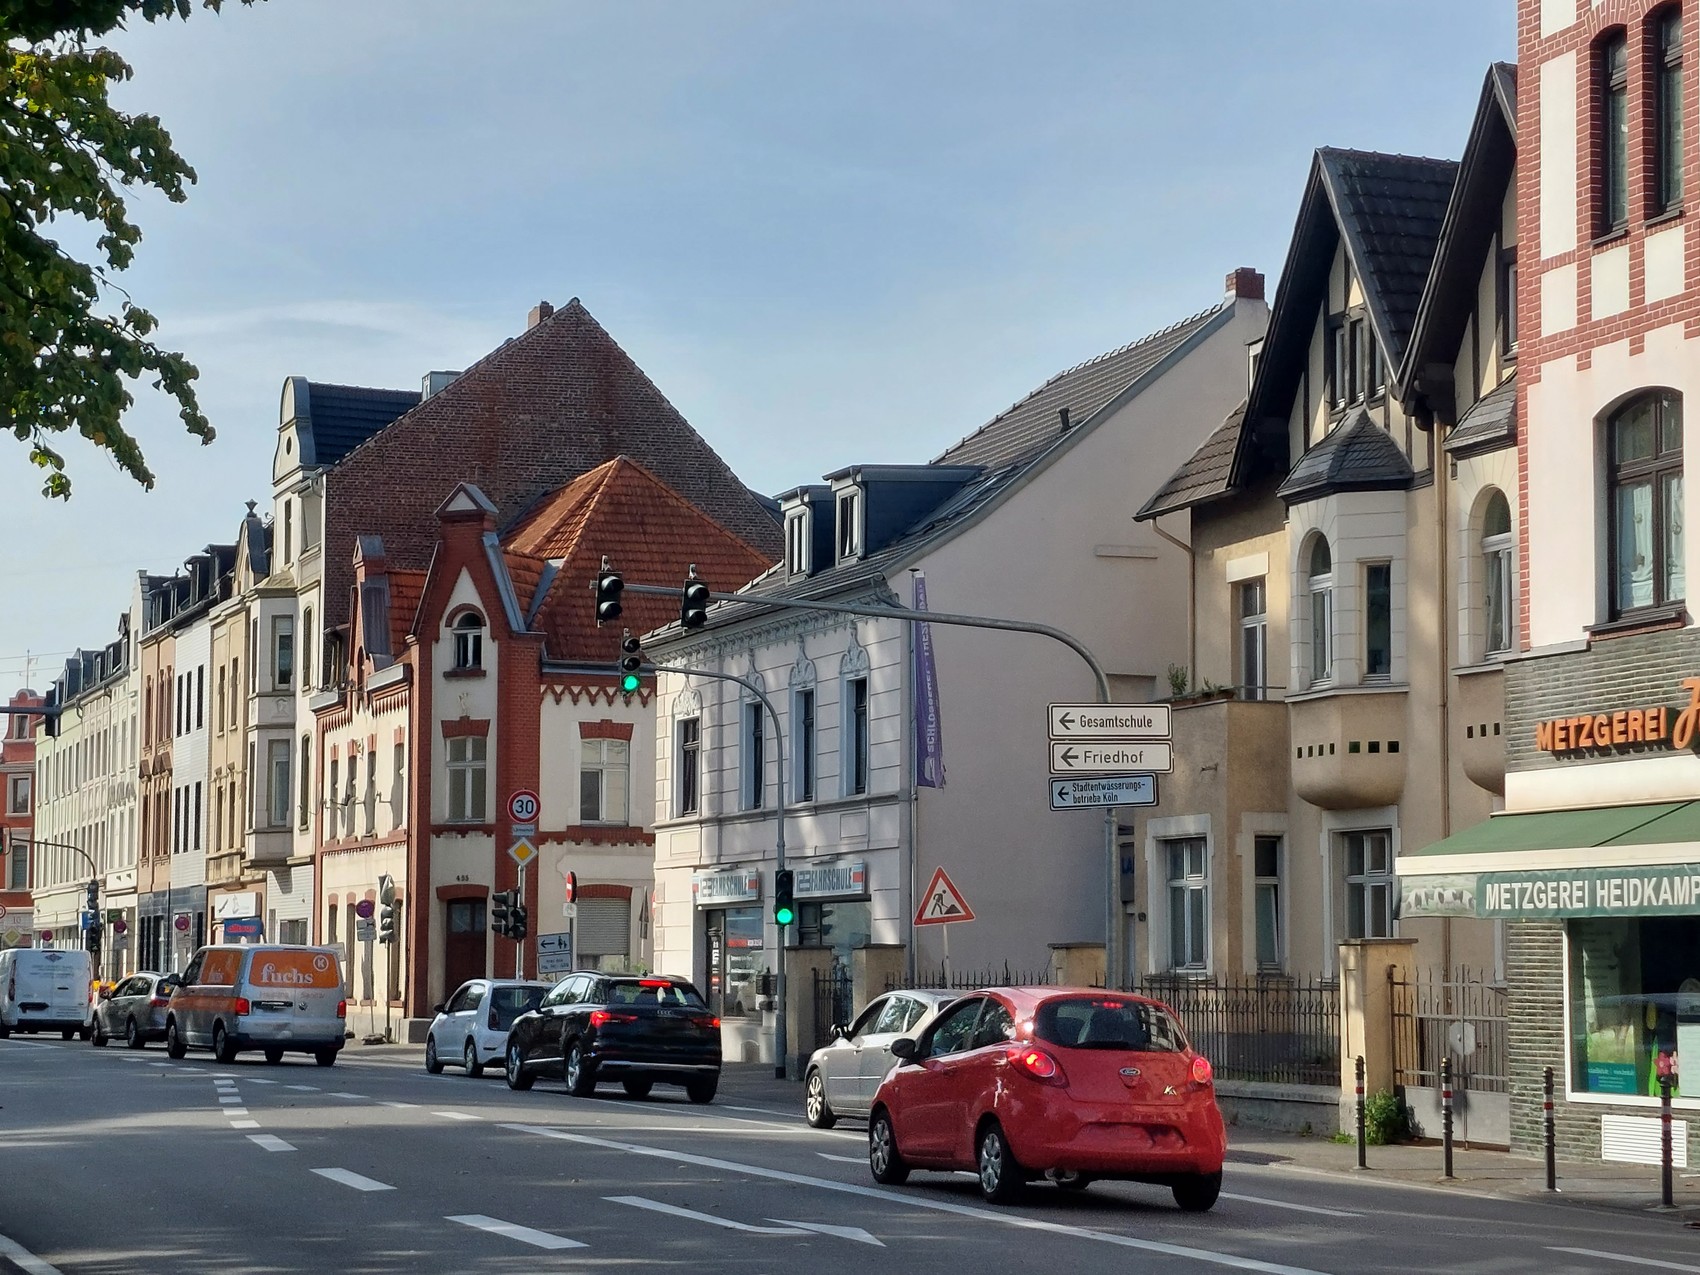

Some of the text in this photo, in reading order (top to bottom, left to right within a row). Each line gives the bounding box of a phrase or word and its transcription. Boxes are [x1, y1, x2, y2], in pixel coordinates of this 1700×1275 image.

[1079, 714, 1153, 728] Gesamtschule
[1535, 705, 1669, 752] METZGEREI
[1083, 750, 1144, 764] Friedhof
[1072, 781, 1146, 793] Stadtentwässerungs-
[1102, 793, 1119, 803] Köln
[515, 799, 534, 814] 30
[1485, 875, 1700, 911] METZGEREI HEIDKAMP
[261, 962, 314, 984] fuchs
